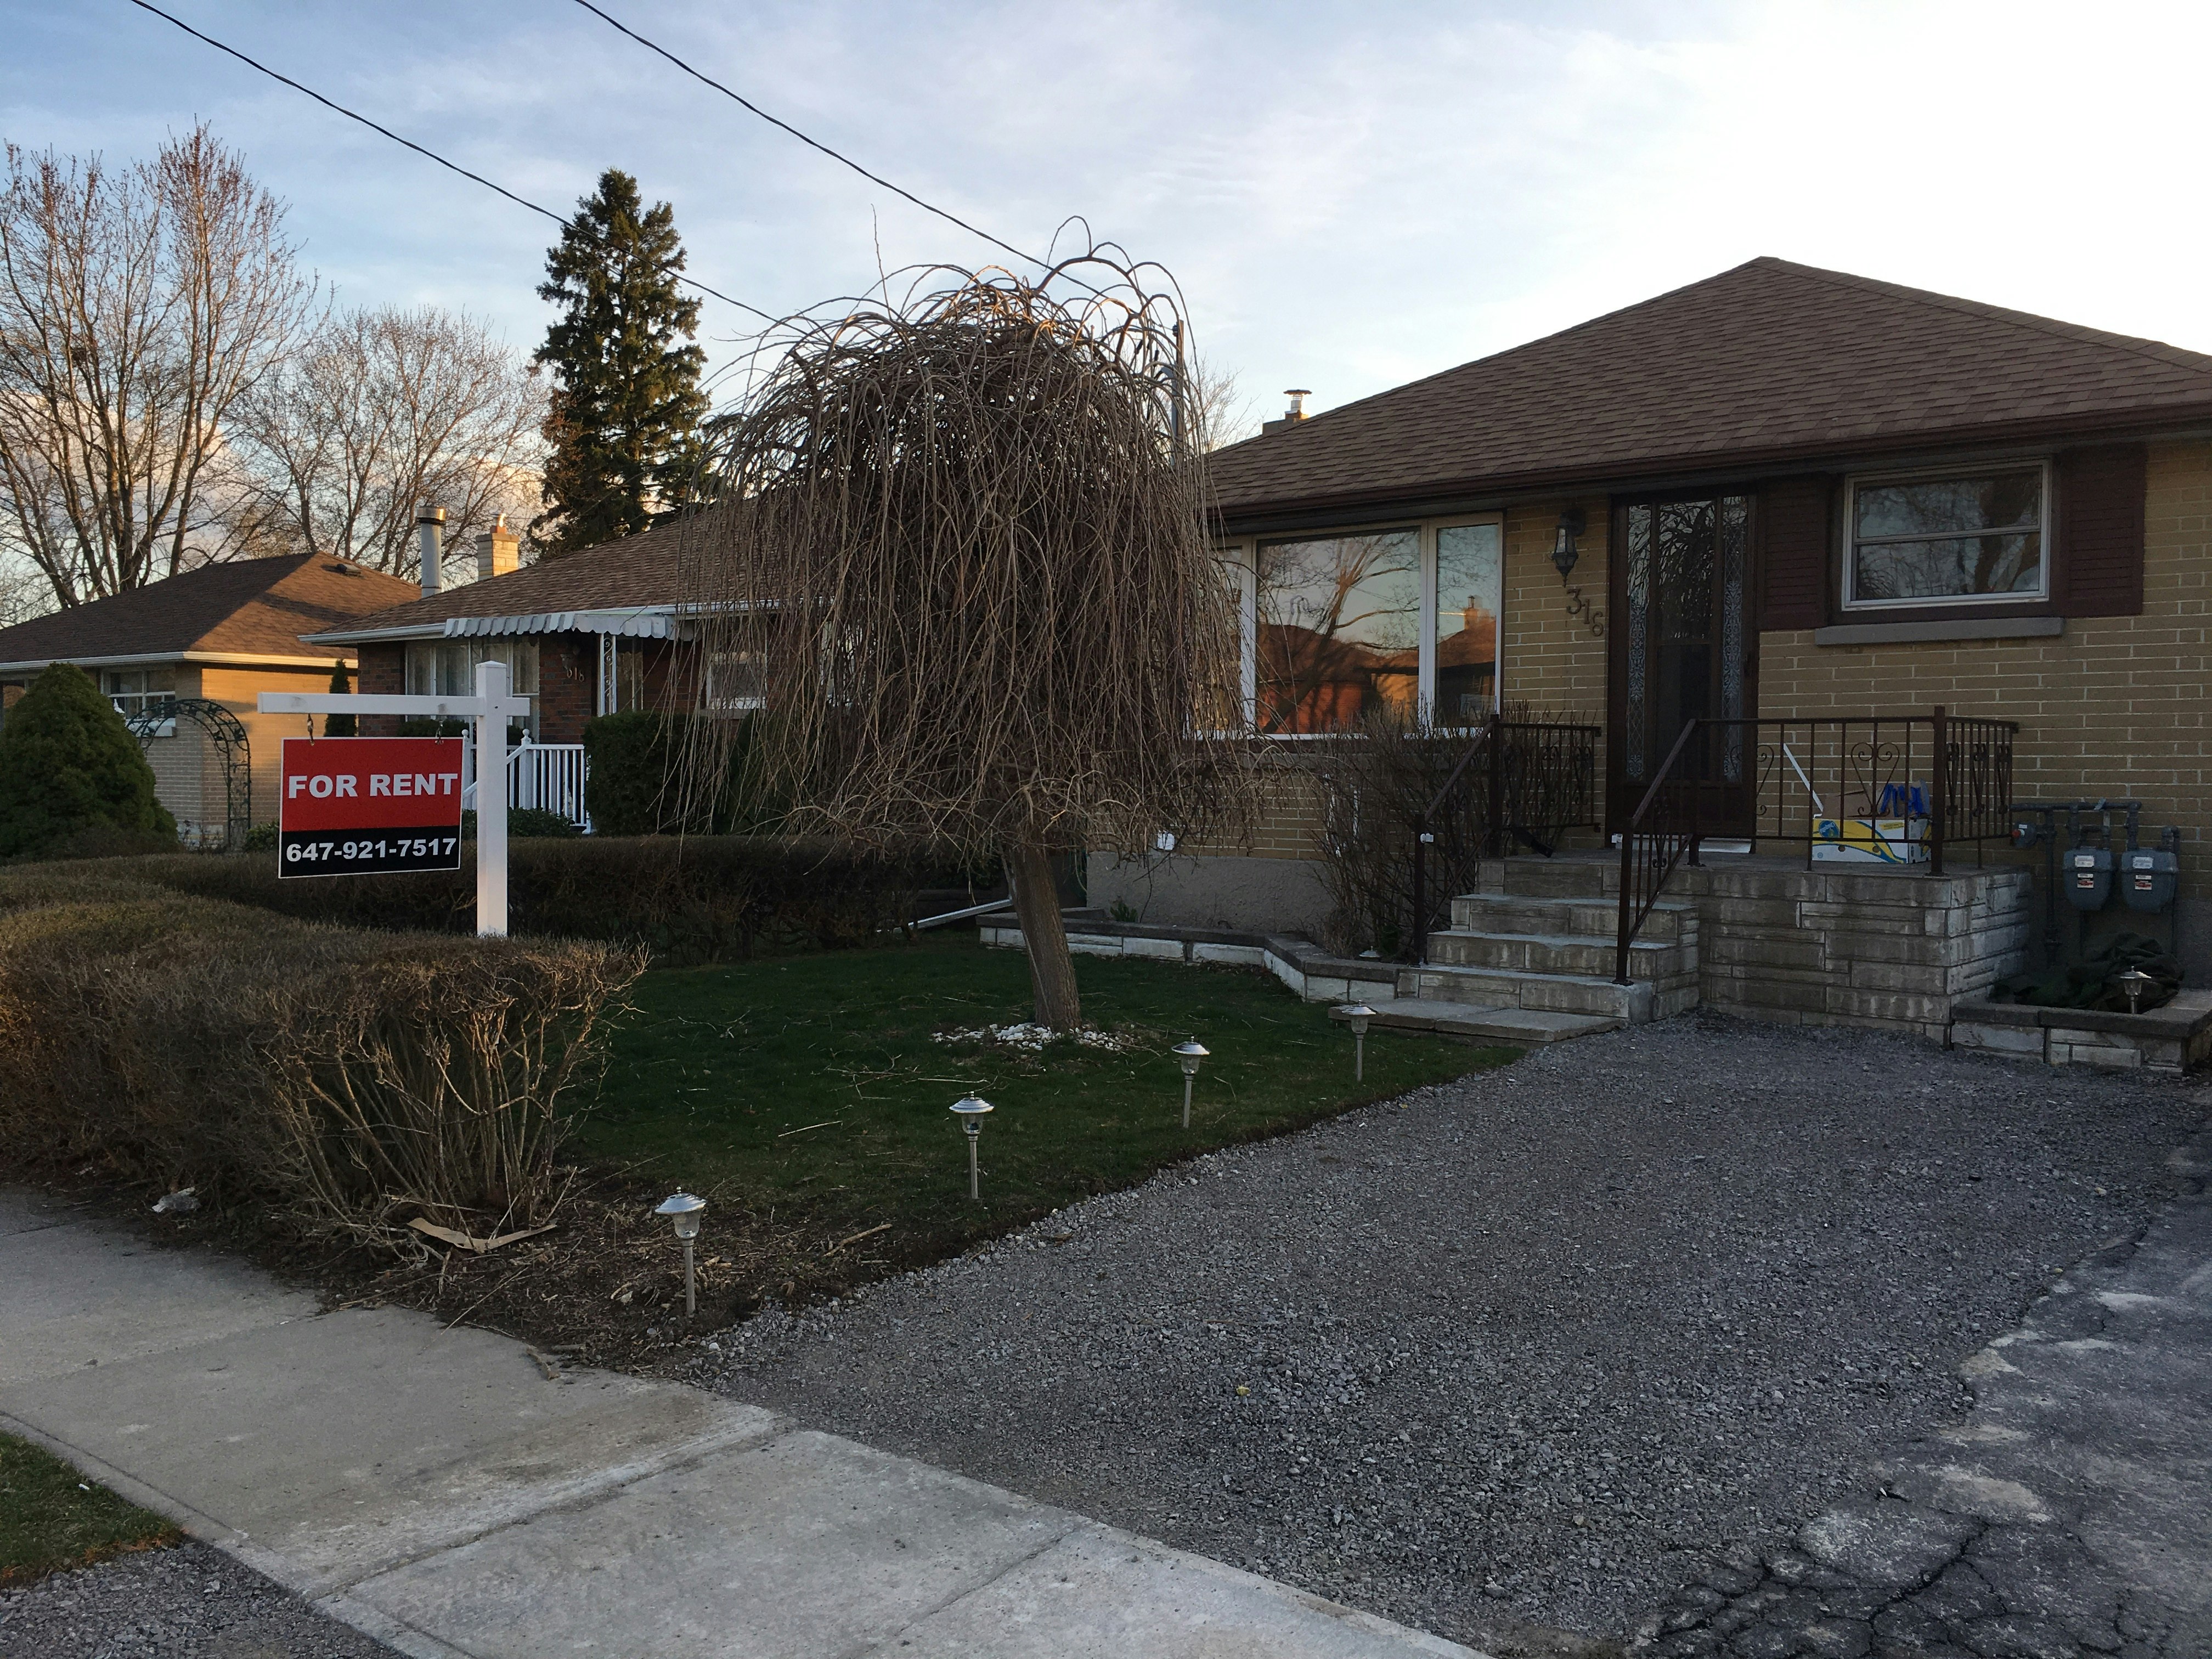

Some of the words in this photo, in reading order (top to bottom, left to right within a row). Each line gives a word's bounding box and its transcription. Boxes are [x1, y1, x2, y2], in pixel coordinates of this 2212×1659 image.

[1566, 588, 1604, 636] 316
[288, 775, 358, 799] FOR
[369, 773, 458, 797] RENT
[286, 838, 456, 862] 647-921-7517
